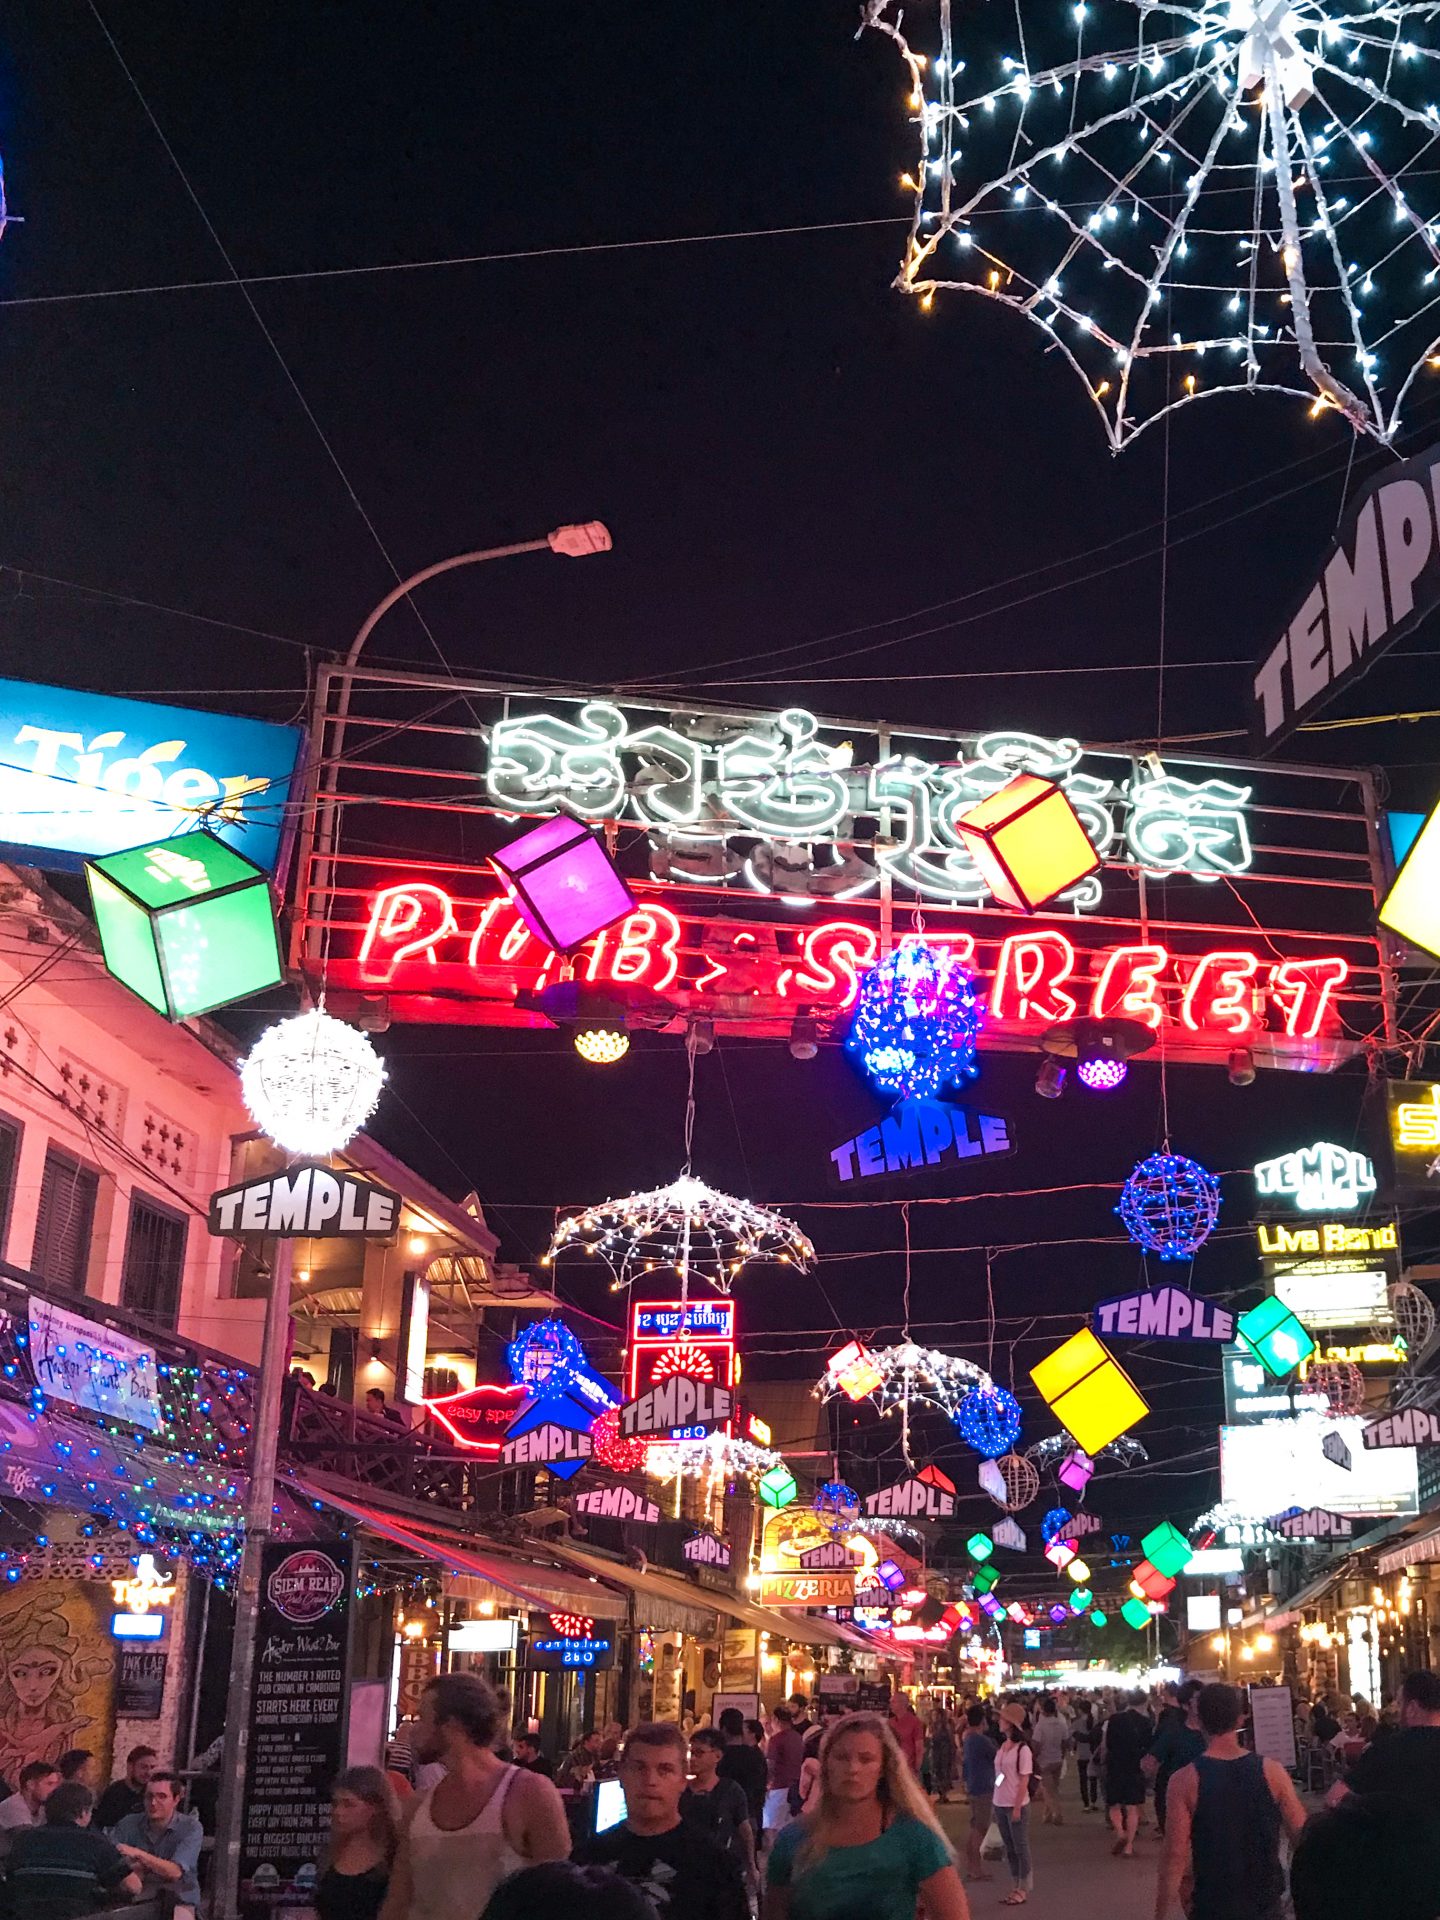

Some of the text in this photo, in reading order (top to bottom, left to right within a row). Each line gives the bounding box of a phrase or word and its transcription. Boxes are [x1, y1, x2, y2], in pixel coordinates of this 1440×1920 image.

[1254, 463, 1440, 738] TEMP
[830, 1105, 1010, 1181] TEMPLE
[216, 1168, 395, 1231] TEMPLE
[1258, 1223, 1399, 1253] Live Band
[1099, 1287, 1233, 1339] TEMPLE
[447, 1405, 517, 1424] easy spe
[622, 1375, 731, 1434] TEMPLE
[502, 1424, 592, 1465] TEMPLE
[576, 1487, 660, 1523] TEMPLE
[866, 1479, 954, 1516] TEMPLE
[1060, 1513, 1100, 1540] TEMPLE
[1282, 1509, 1352, 1536] TEMPLE
[685, 1536, 730, 1566] TEMPLE
[801, 1543, 864, 1568] TEMPLE
[111, 1578, 177, 1614] Tiger
[274, 1577, 338, 1595] SIEM REAP
[763, 1578, 853, 1600] PIZZERIA
[855, 1587, 901, 1606] TEMPLE
[122, 1655, 165, 1672] INK LAB
[260, 1671, 274, 1682] THE
[275, 1670, 309, 1682] NUMBER
[315, 1669, 341, 1681] RATED
[257, 1683, 272, 1695] PUB
[273, 1683, 296, 1694] CRAWL
[305, 1681, 341, 1693] CAMBODIA
[256, 1699, 340, 1714] STARTS HERE EVERY
[248, 1817, 267, 1829] EVERY
[268, 1817, 280, 1828] DAY
[281, 1816, 298, 1828] FROM
[249, 1805, 272, 1815] HAPPY
[273, 1804, 293, 1815] HOUR
[294, 1804, 303, 1815] AT
[304, 1804, 317, 1815] THE
[248, 1833, 262, 1845] THE
[263, 1832, 295, 1844] BIGGEST
[259, 1846, 280, 1857] LATEST
